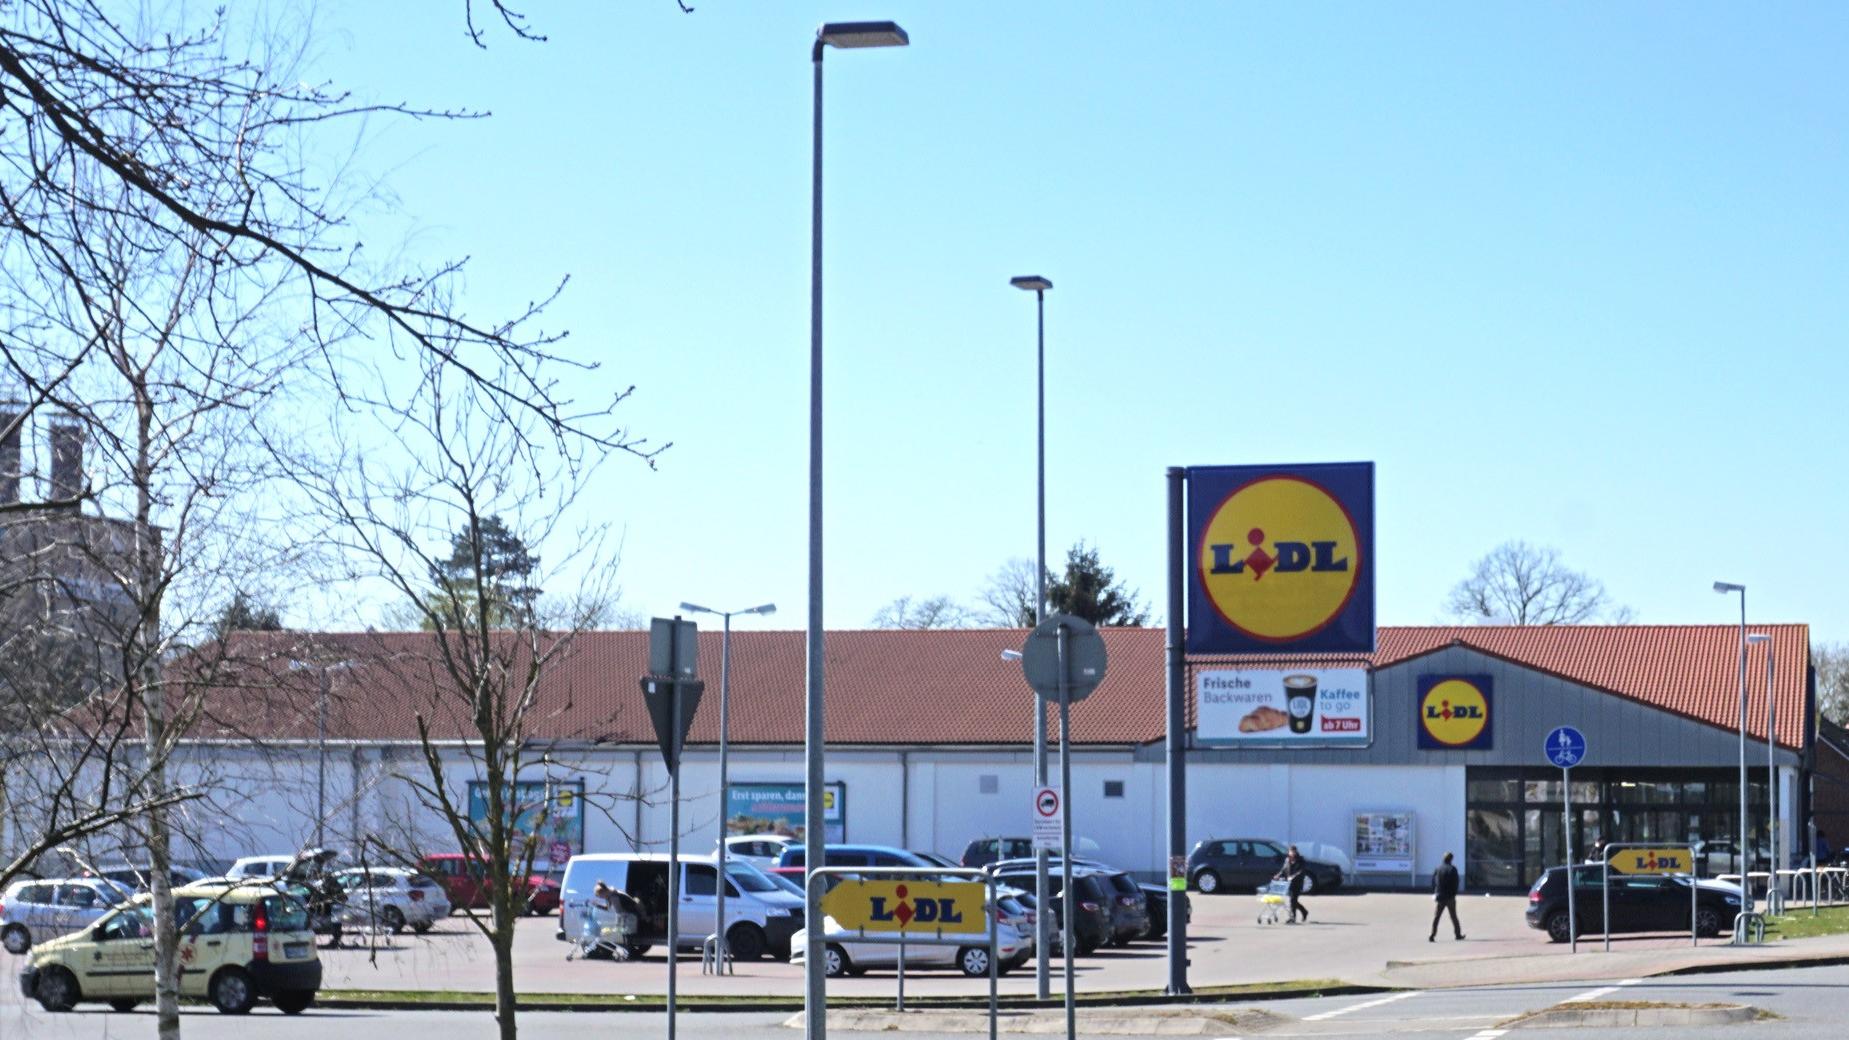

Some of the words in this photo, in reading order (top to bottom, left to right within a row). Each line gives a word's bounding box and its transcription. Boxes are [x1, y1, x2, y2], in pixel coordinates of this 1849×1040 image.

[1203, 677, 1251, 689] Frische
[1203, 692, 1272, 704] Backwaren
[1320, 689, 1360, 700] Kaffee
[1320, 701, 1332, 711] to
[1335, 702, 1351, 713] go
[1323, 720, 1335, 731] ab
[1335, 720, 1341, 731] 7
[1342, 720, 1359, 731] Uhr
[732, 790, 749, 801] Erst
